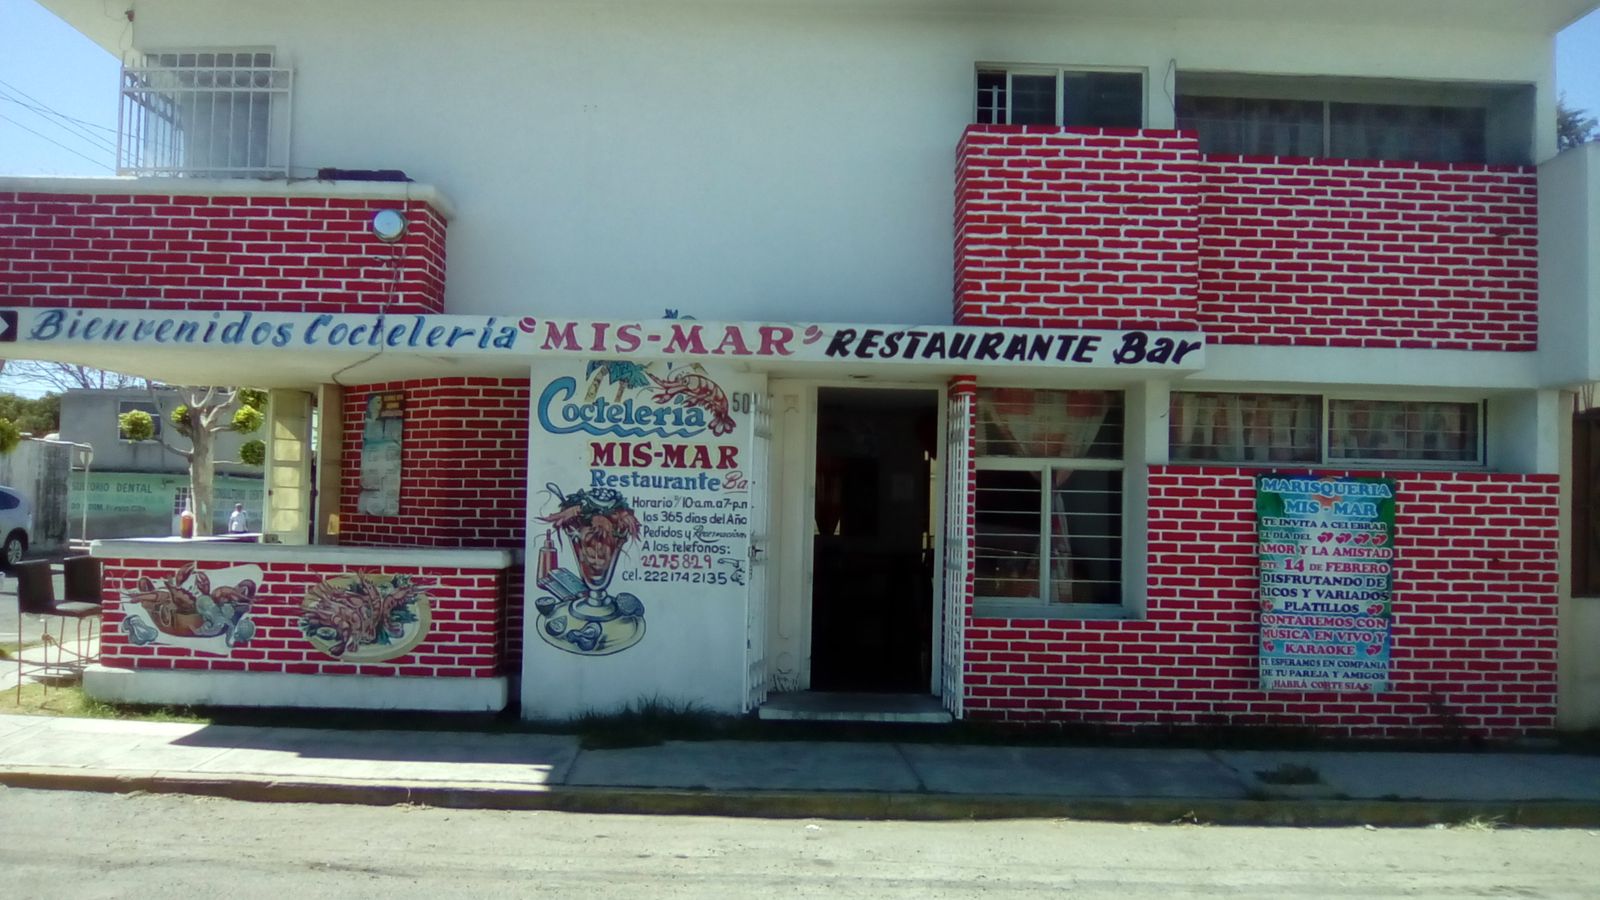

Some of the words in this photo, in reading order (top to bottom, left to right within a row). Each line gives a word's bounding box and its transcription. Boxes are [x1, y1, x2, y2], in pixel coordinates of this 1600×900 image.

[28, 308, 292, 348] Bienvenidos
[825, 329, 1103, 363] RESTAURANTE
[1113, 331, 1202, 365] Bar
[590, 441, 738, 469] MIS-MAR
[590, 469, 721, 491] Restaurante
[116, 482, 153, 494] DENTAL
[1261, 478, 1393, 497] MARISQUERIA
[632, 497, 673, 508] Horario
[1284, 499, 1320, 515] MIS
[1333, 501, 1379, 517] MAR
[643, 512, 659, 522] los
[661, 511, 683, 523] 365
[709, 513, 725, 524] del
[726, 513, 748, 525] Año
[1263, 518, 1276, 526] TE
[1279, 518, 1317, 528] INVITA
[1320, 521, 1329, 529] A
[1331, 521, 1387, 531] CELEBRAR
[643, 525, 683, 538] Pedidos
[685, 528, 692, 541] y
[1293, 533, 1312, 541] DEL
[641, 541, 650, 551] A
[653, 542, 669, 552] los
[1260, 543, 1296, 555] AMOR
[1299, 545, 1308, 555] Y
[1311, 545, 1329, 556] LA
[1332, 547, 1393, 559] AMISTAD
[1284, 558, 1305, 573] 14
[1309, 563, 1323, 571] DE
[1325, 562, 1389, 574] FEBRERO
[1262, 573, 1363, 587] DISFRUTANDO
[1366, 577, 1386, 588] DE
[1260, 586, 1298, 598] RICOS
[1302, 588, 1312, 599] Y
[1316, 589, 1389, 601] VARIADOS
[1284, 601, 1360, 614] PLATILLOS
[1261, 615, 1352, 627] CONTAREMOS
[1356, 618, 1387, 628] CON
[1315, 631, 1333, 641] EN
[1337, 632, 1373, 642] VIVO
[1375, 633, 1386, 644] Y
[1285, 643, 1356, 656] KARAOKE
[1271, 658, 1321, 668] ESPERAMOS
[1323, 660, 1335, 668] EN
[1262, 669, 1273, 677] DE
[1276, 669, 1288, 677] TU
[1289, 670, 1329, 679] PAREJA
[1332, 671, 1340, 679] Y
[1343, 671, 1386, 680] AMIGOS
